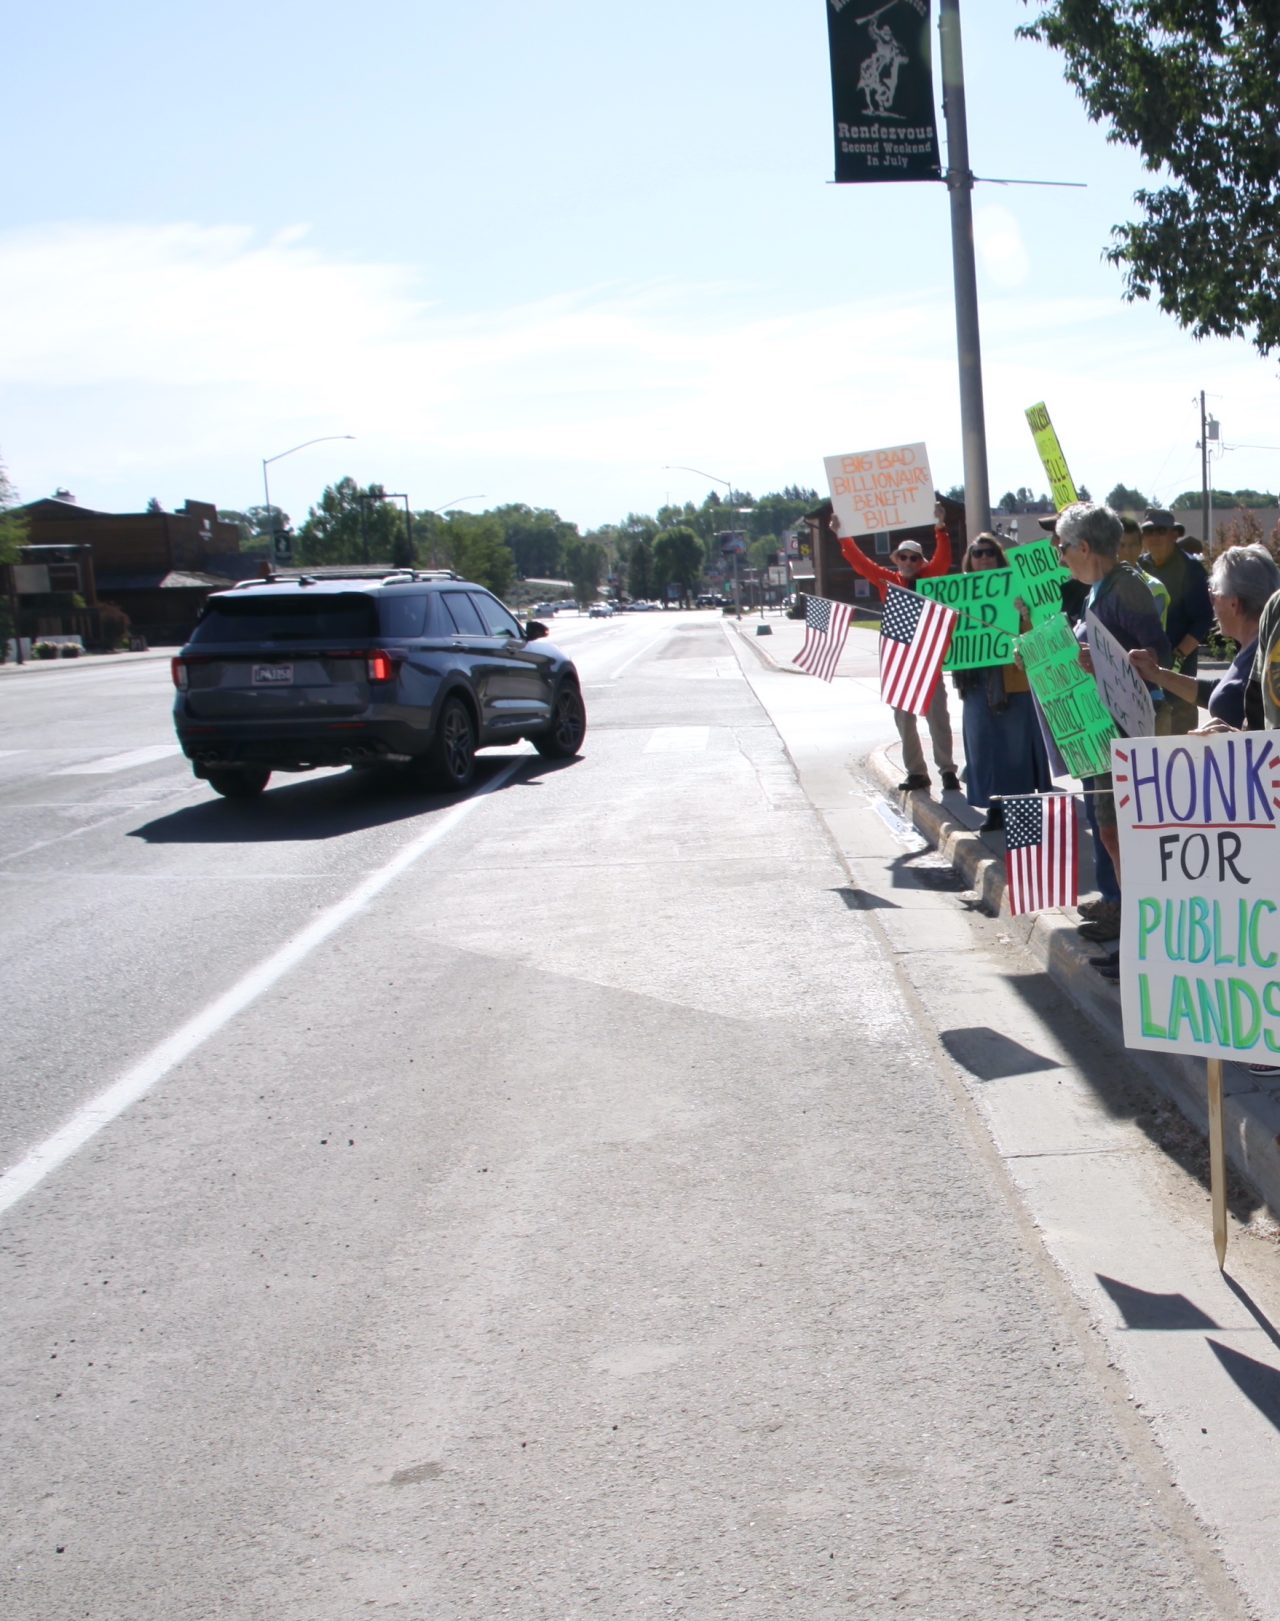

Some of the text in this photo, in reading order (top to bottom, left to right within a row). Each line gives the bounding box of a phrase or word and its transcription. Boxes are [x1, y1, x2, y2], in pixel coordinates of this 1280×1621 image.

[838, 122, 933, 139] Rendezvous
[841, 141, 932, 153] Second Weekend
[867, 155, 908, 168] In July
[841, 448, 916, 474] BIG BAD
[832, 466, 929, 496] BILLIONAIRE
[853, 486, 919, 511] BENEFIT
[864, 507, 907, 529] BILL
[1014, 546, 1060, 578] PUBLI
[921, 571, 1013, 604] PROTECT
[956, 603, 998, 632] ILD
[1041, 692, 1085, 736] PROTECT
[1130, 738, 1275, 823] HONK
[1159, 831, 1252, 884] FOR
[1138, 896, 1278, 968] PUBLIC
